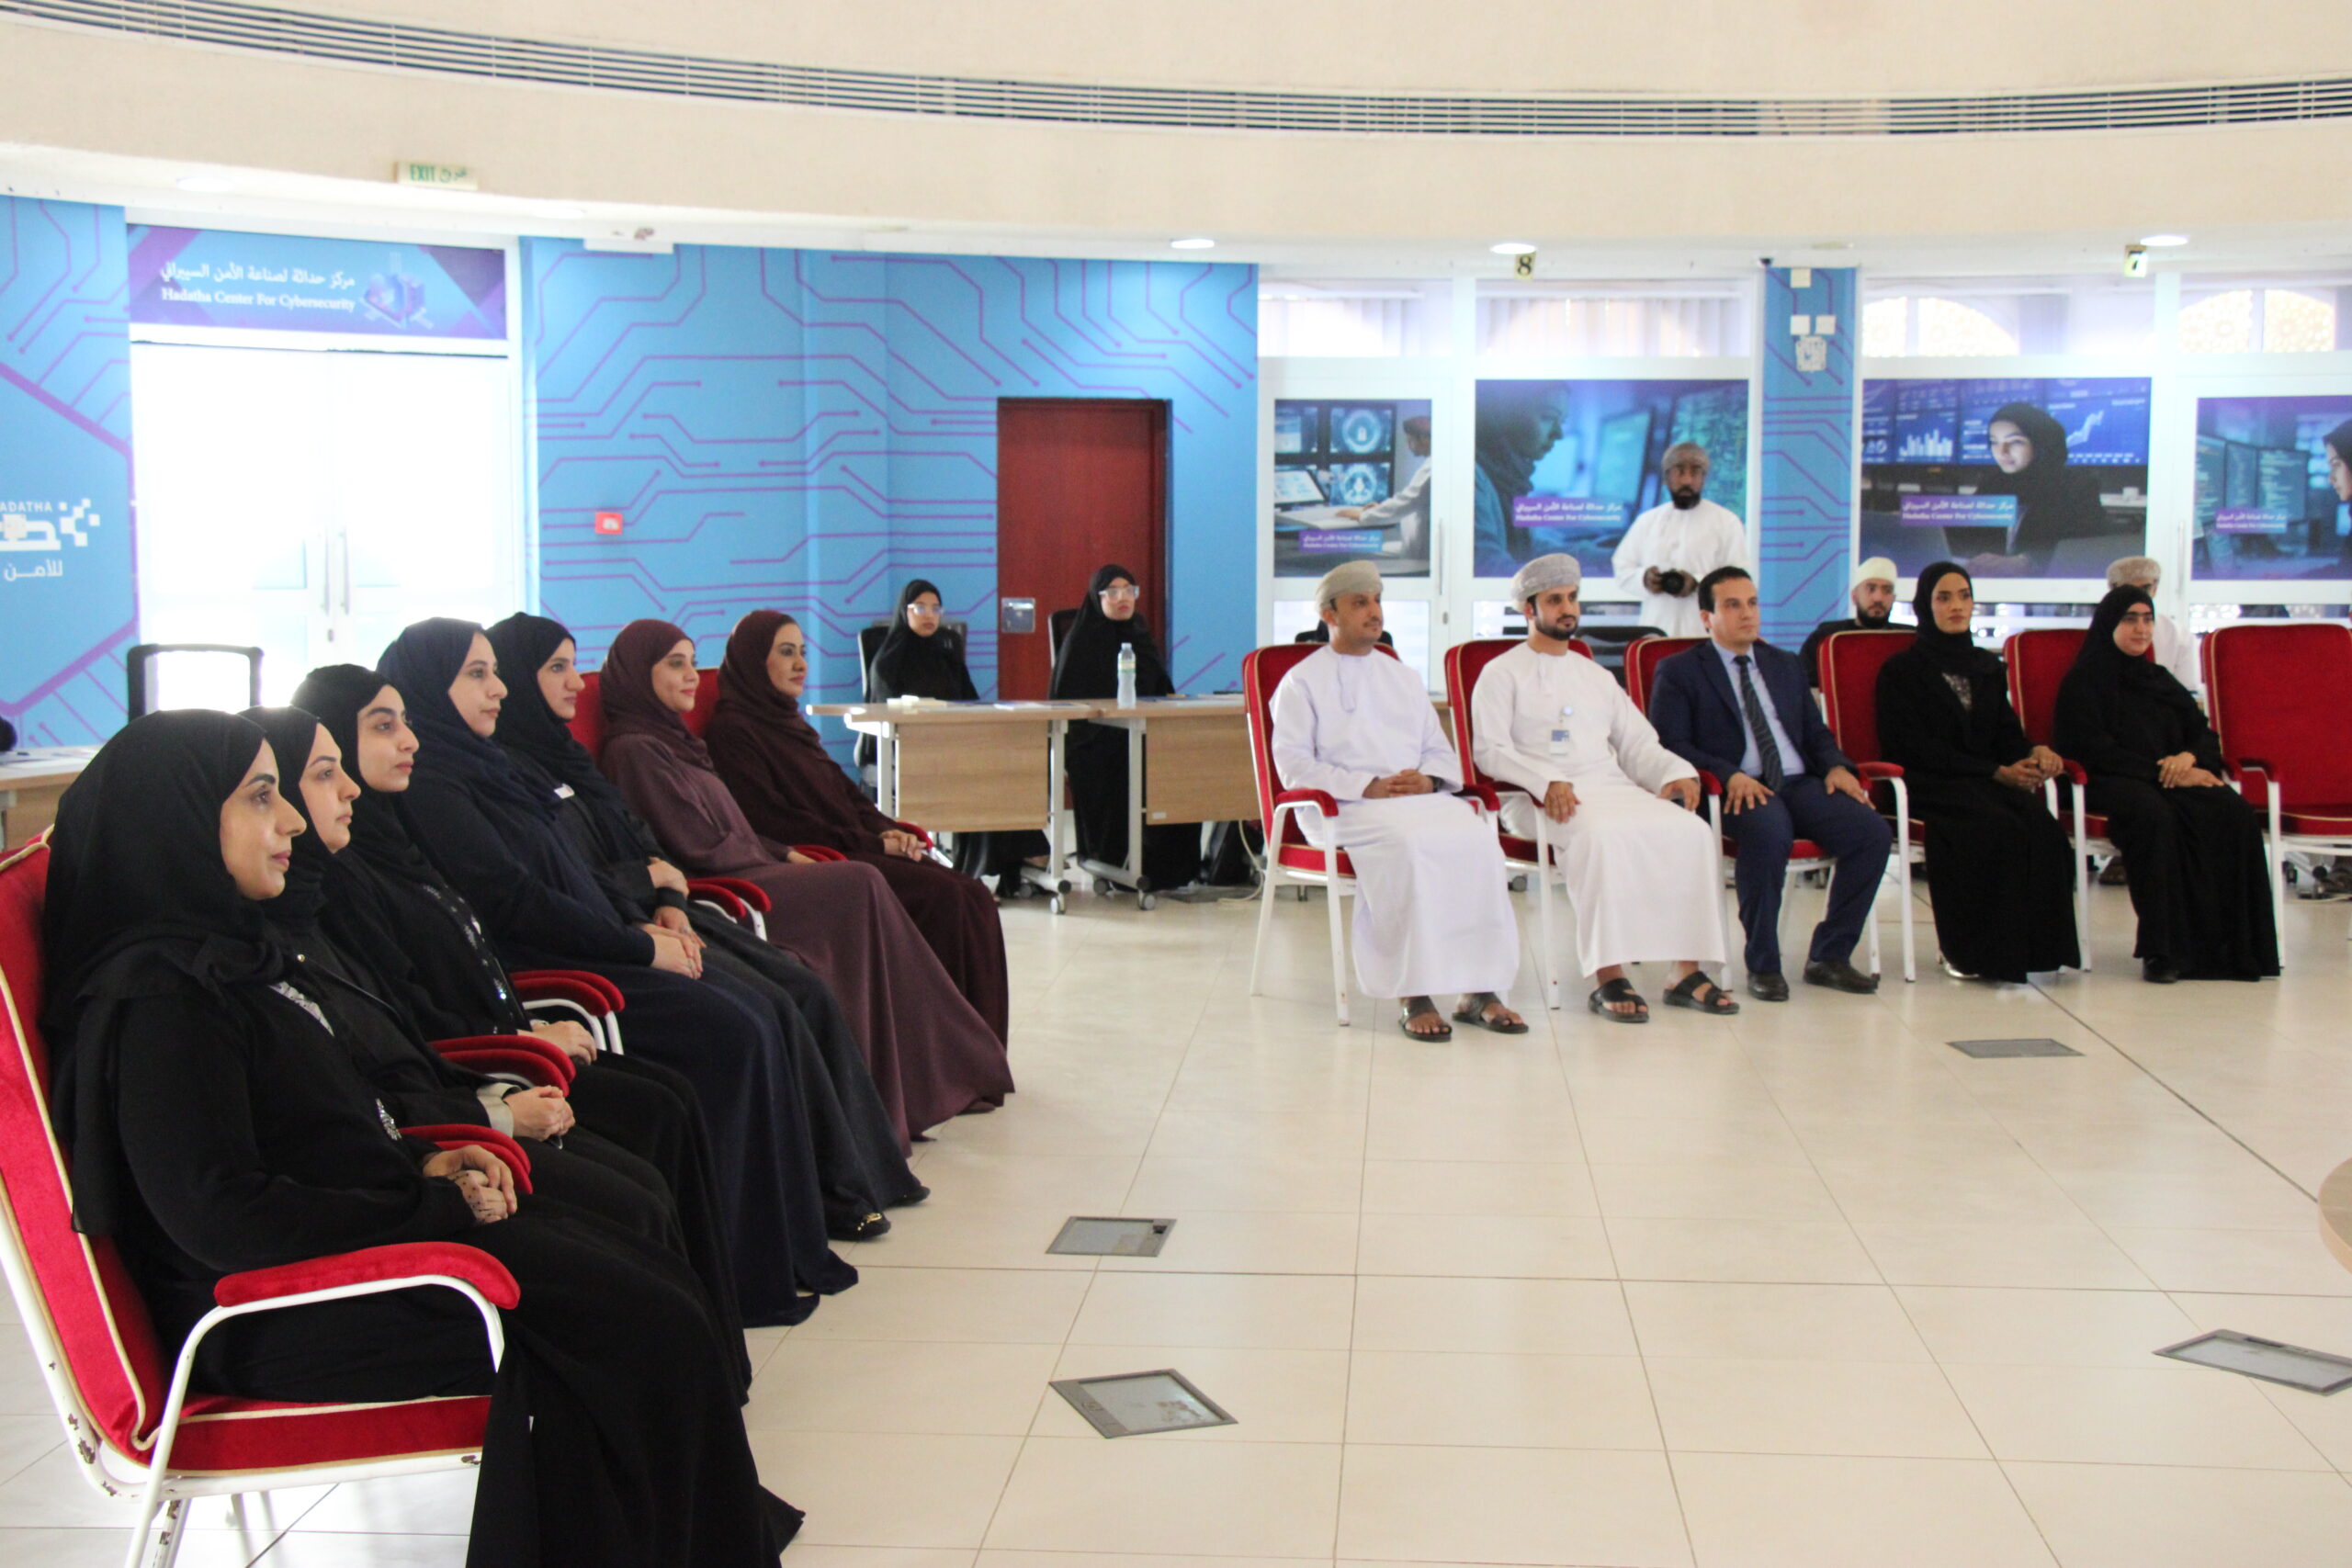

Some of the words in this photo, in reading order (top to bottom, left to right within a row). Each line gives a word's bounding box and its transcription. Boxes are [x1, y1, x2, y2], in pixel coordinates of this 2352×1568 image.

[410, 164, 435, 182] EXIT
[1517, 255, 1532, 276] 8
[2127, 250, 2143, 271] 7
[161, 287, 211, 303] Hadatha
[214, 290, 254, 305] Center
[256, 293, 277, 307] For
[279, 294, 356, 312] Cybersecurity
